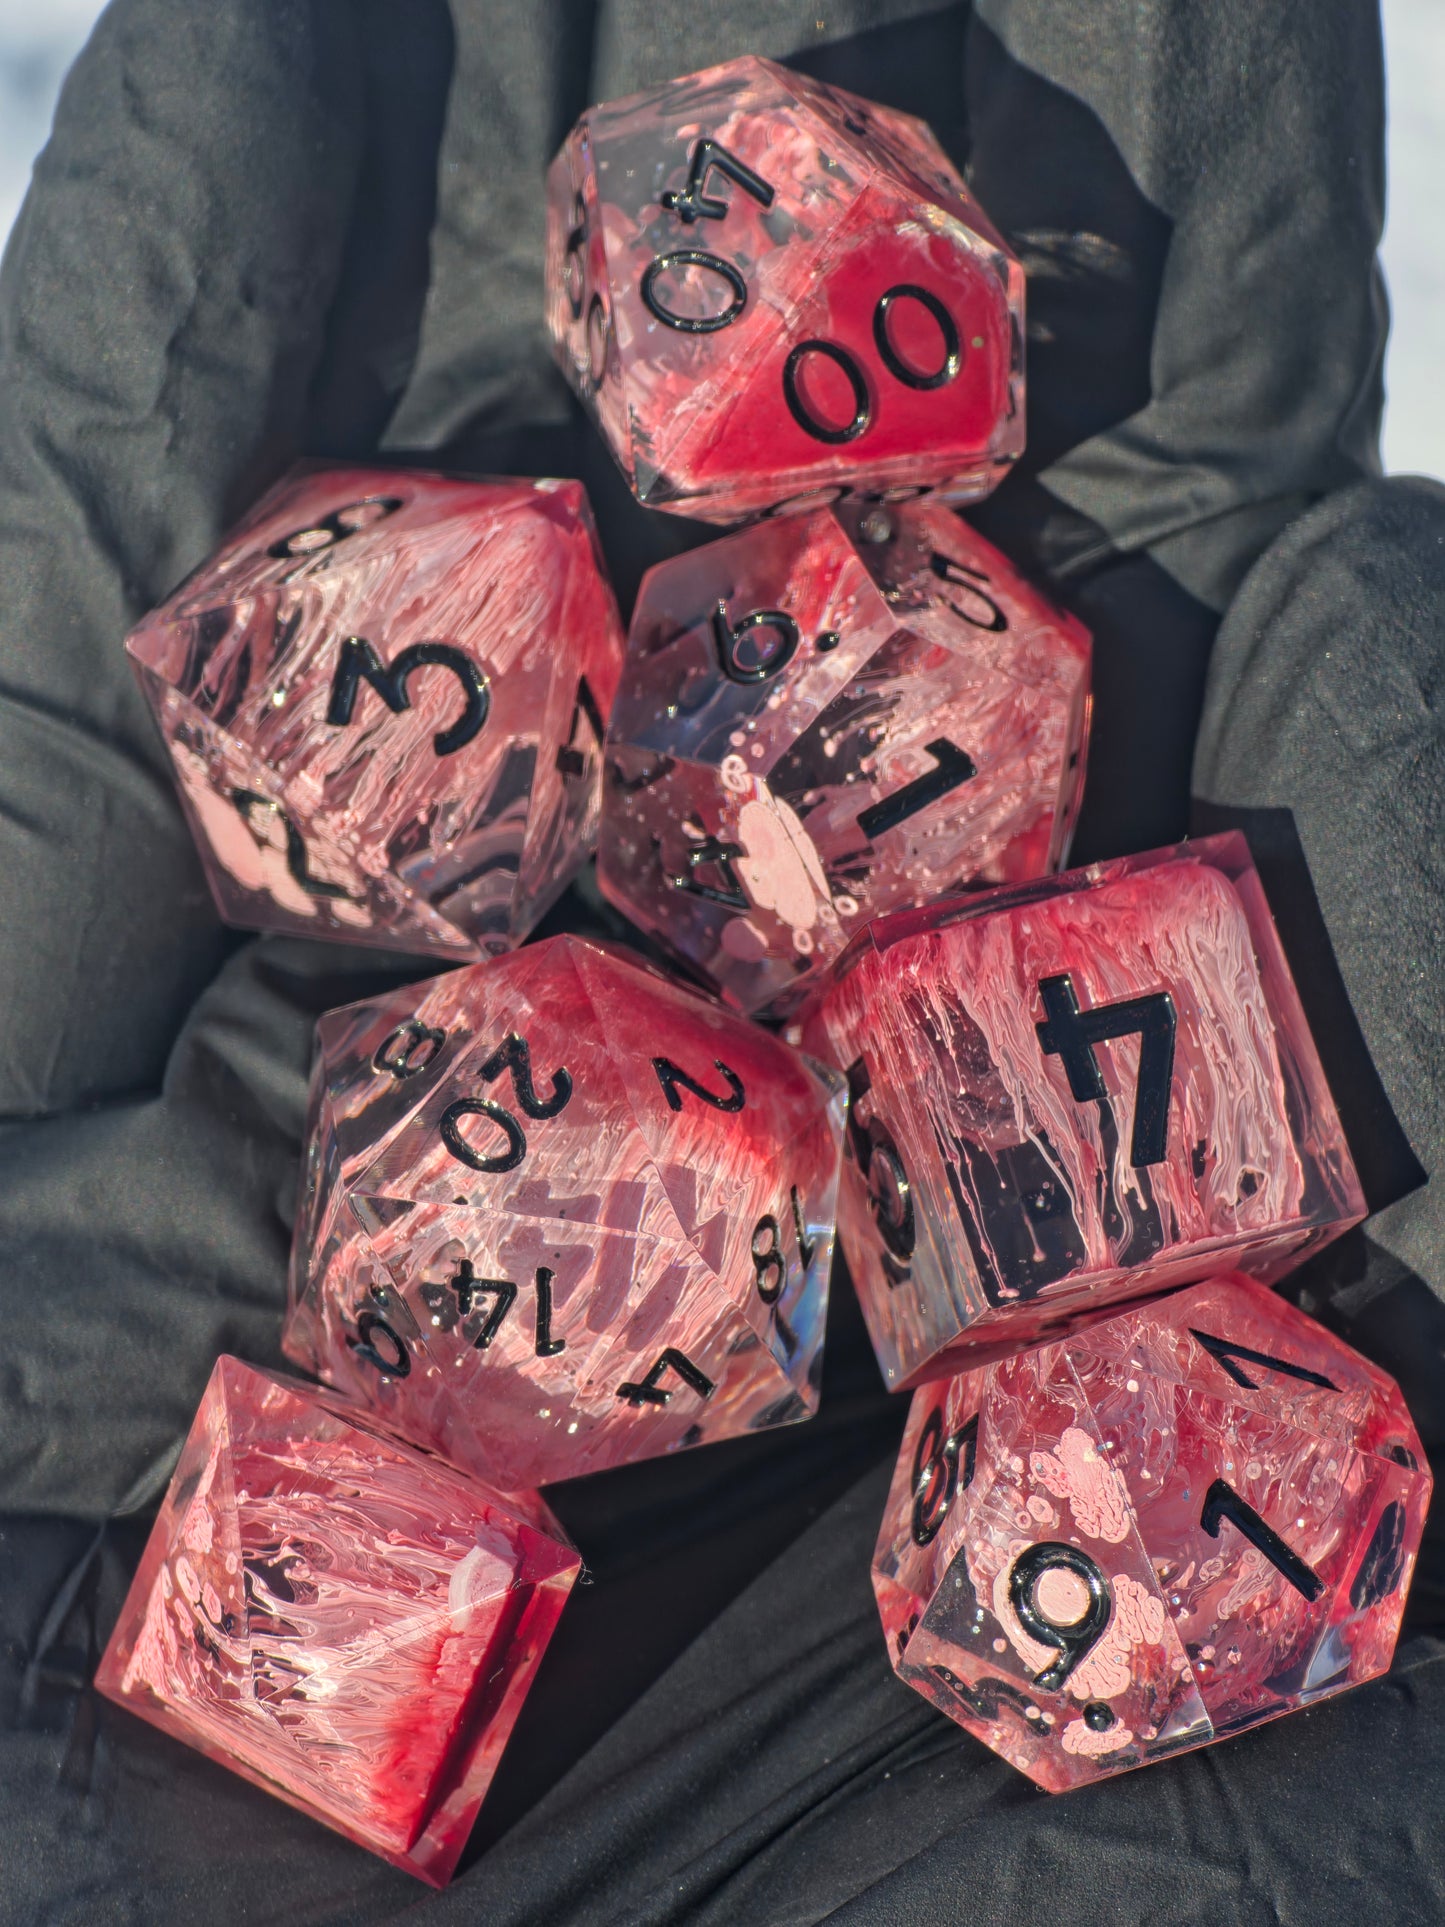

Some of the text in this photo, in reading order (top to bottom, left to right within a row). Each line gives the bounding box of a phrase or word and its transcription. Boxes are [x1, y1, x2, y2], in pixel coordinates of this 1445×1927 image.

[641, 138, 774, 334] 40
[782, 284, 960, 445] 00
[267, 496, 405, 559] 8
[930, 550, 1008, 633] 5
[326, 636, 489, 757] 3
[857, 737, 977, 840] 1
[668, 835, 752, 911] 4
[371, 1020, 447, 1081] 8
[651, 1057, 746, 1113] 2
[1035, 973, 1177, 1168] 4
[439, 1031, 574, 1174] 20
[451, 1258, 566, 1357] 14
[615, 1347, 717, 1407] 4
[1200, 1477, 1326, 1603] 1
